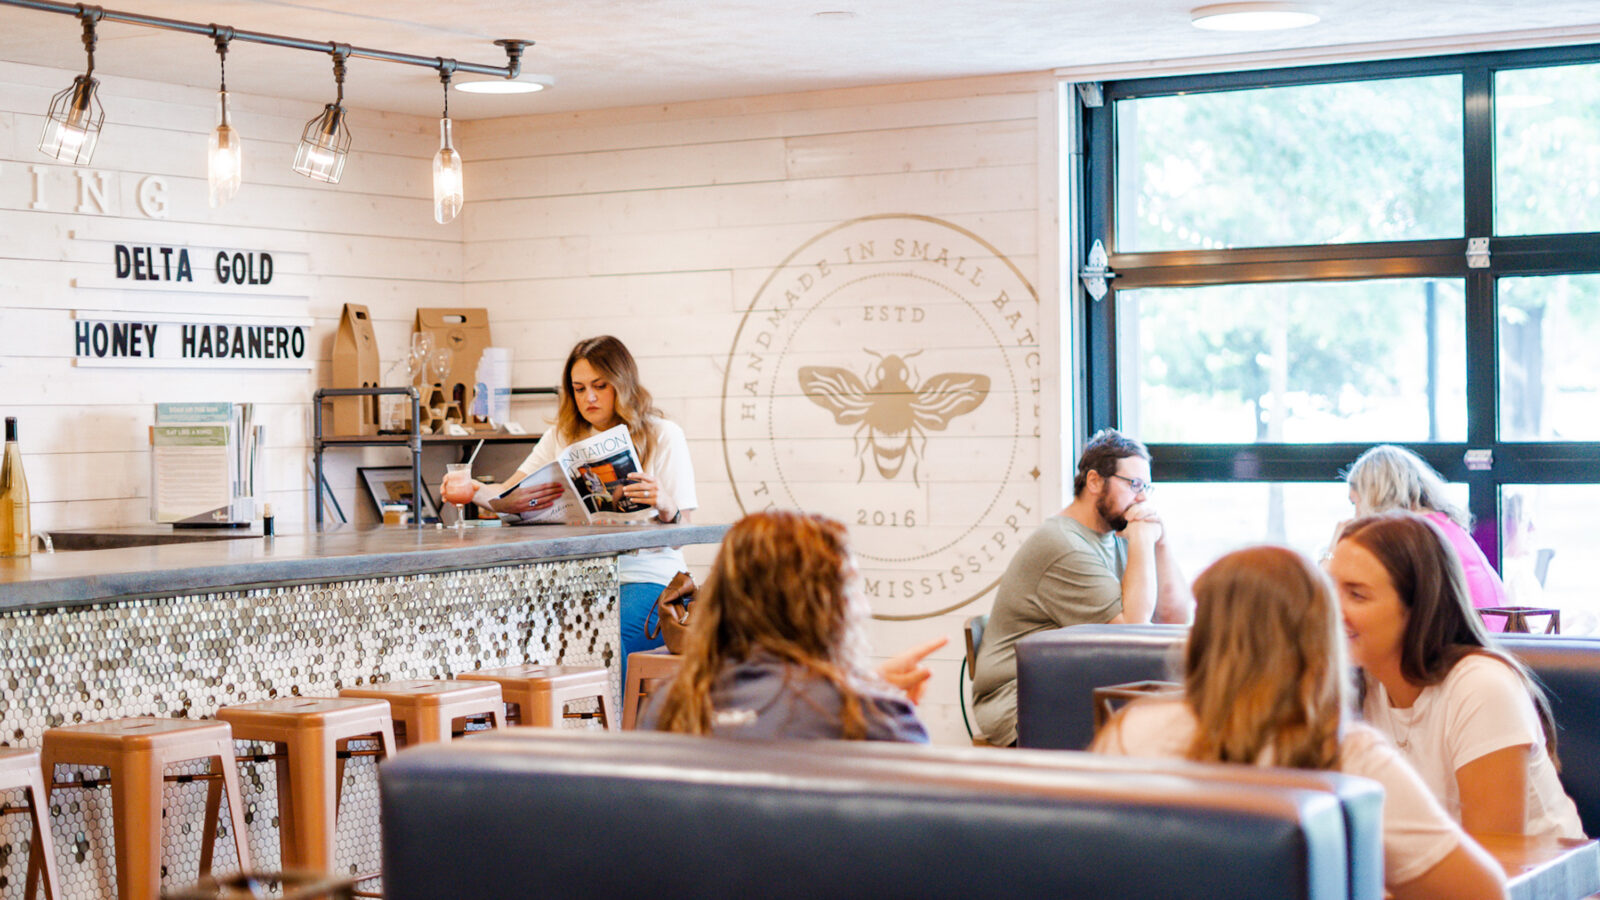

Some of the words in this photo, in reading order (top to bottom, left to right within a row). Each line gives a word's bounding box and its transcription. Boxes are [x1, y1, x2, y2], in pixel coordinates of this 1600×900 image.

[0, 164, 168, 218] ING
[114, 244, 193, 282] DELTA
[215, 250, 273, 285] GOLD
[740, 259, 831, 421] HANDMADE
[843, 240, 876, 265] IN
[893, 238, 983, 288] SMALL
[863, 305, 926, 323] ESTD
[75, 321, 158, 358] HONEY
[181, 324, 305, 359] HABANERO
[856, 509, 917, 528] 2016
[863, 499, 1031, 598] MISSISSIPPI
